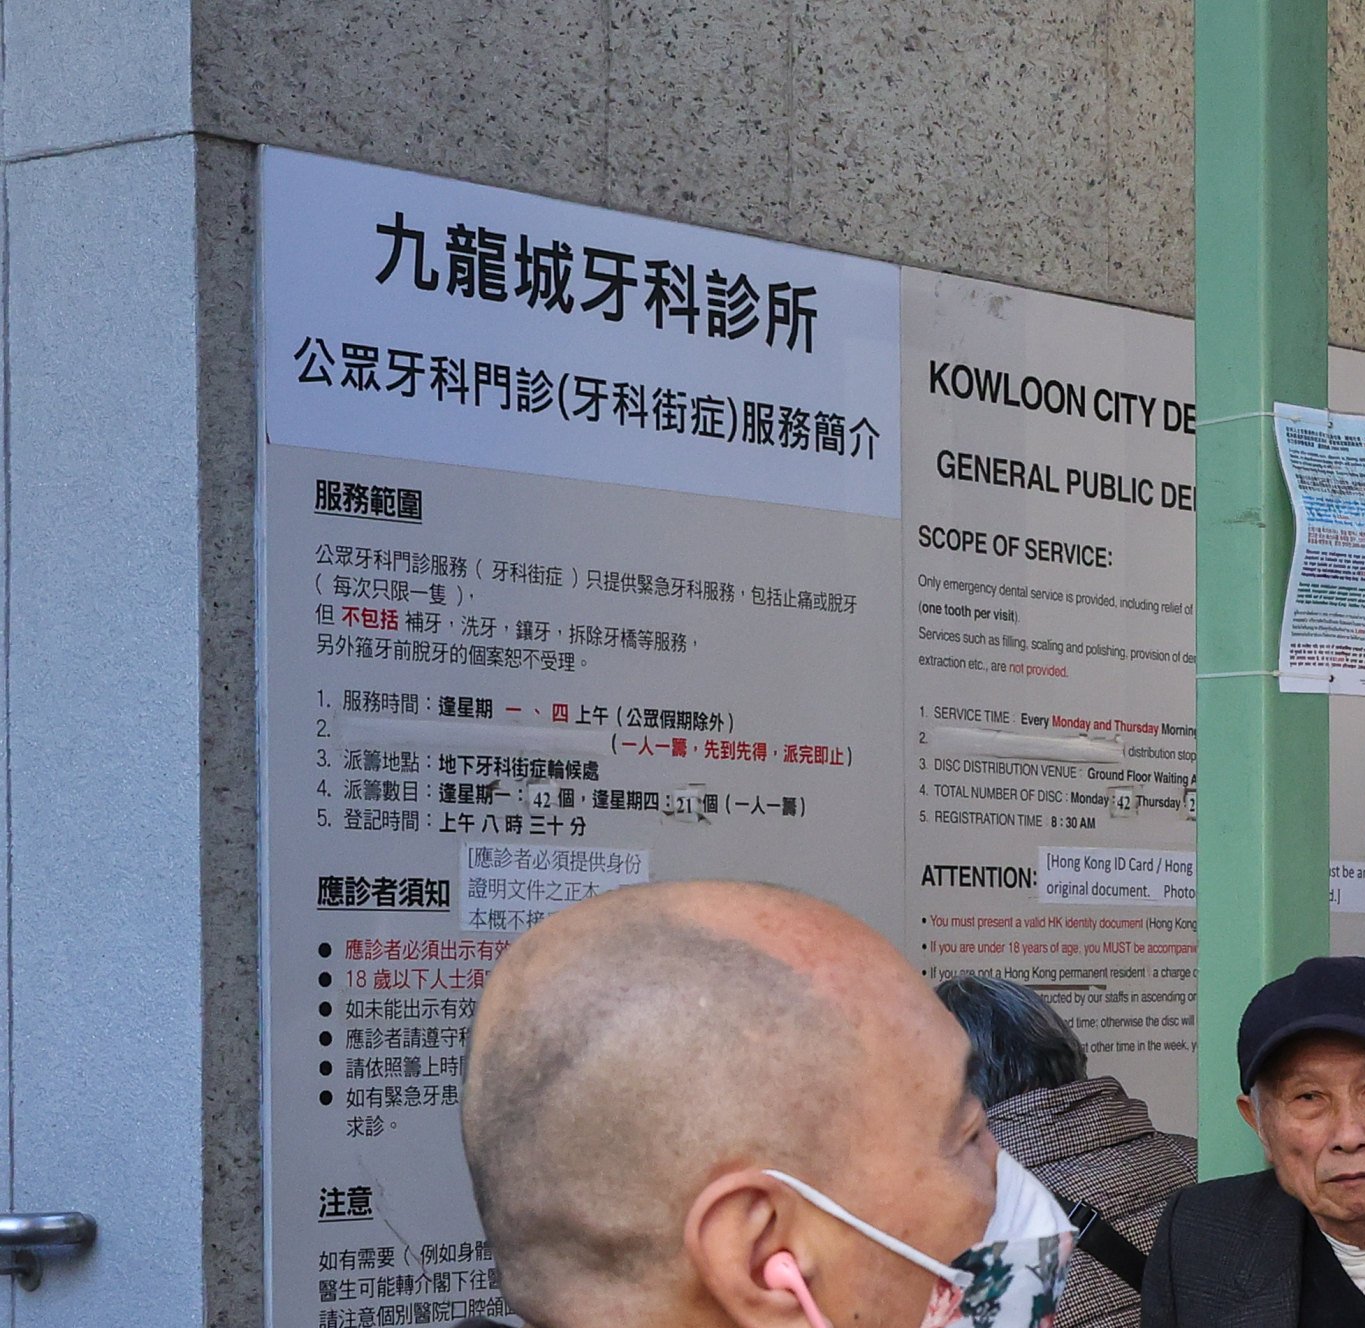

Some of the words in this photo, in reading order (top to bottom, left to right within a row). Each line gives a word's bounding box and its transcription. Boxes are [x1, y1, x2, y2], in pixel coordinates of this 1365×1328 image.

[375, 211, 818, 354] 九龍城牙科診所
[294, 336, 881, 460] 公眾牙科門診(牙科街症)服務簡介
[929, 359, 1087, 418] KOWLOON
[1093, 388, 1156, 430] CITY
[936, 448, 1060, 495] GENERAL
[1066, 468, 1154, 508] PUBLIC
[314, 479, 422, 520] 服務範圍
[918, 525, 987, 554] SCOPE
[993, 534, 1020, 557] OF
[1024, 538, 1112, 568] SERVICE:
[918, 601, 942, 615] (one
[944, 604, 972, 618] tooth
[974, 608, 991, 622] per
[993, 608, 1020, 625] visit).
[921, 864, 1037, 888] ATTENTION:
[1047, 852, 1081, 872] [Hong
[1084, 856, 1112, 874] Kong
[1114, 856, 1126, 870] ID
[1128, 857, 1154, 872] Card
[1156, 858, 1162, 874] /
[1164, 859, 1193, 877] Hong
[317, 876, 450, 908] 應診者須知
[1046, 880, 1088, 898] original
[1091, 881, 1156, 901] document.
[1164, 884, 1196, 899] Photo
[346, 1115, 397, 1138] 求診。
[318, 1186, 373, 1219] 注意
